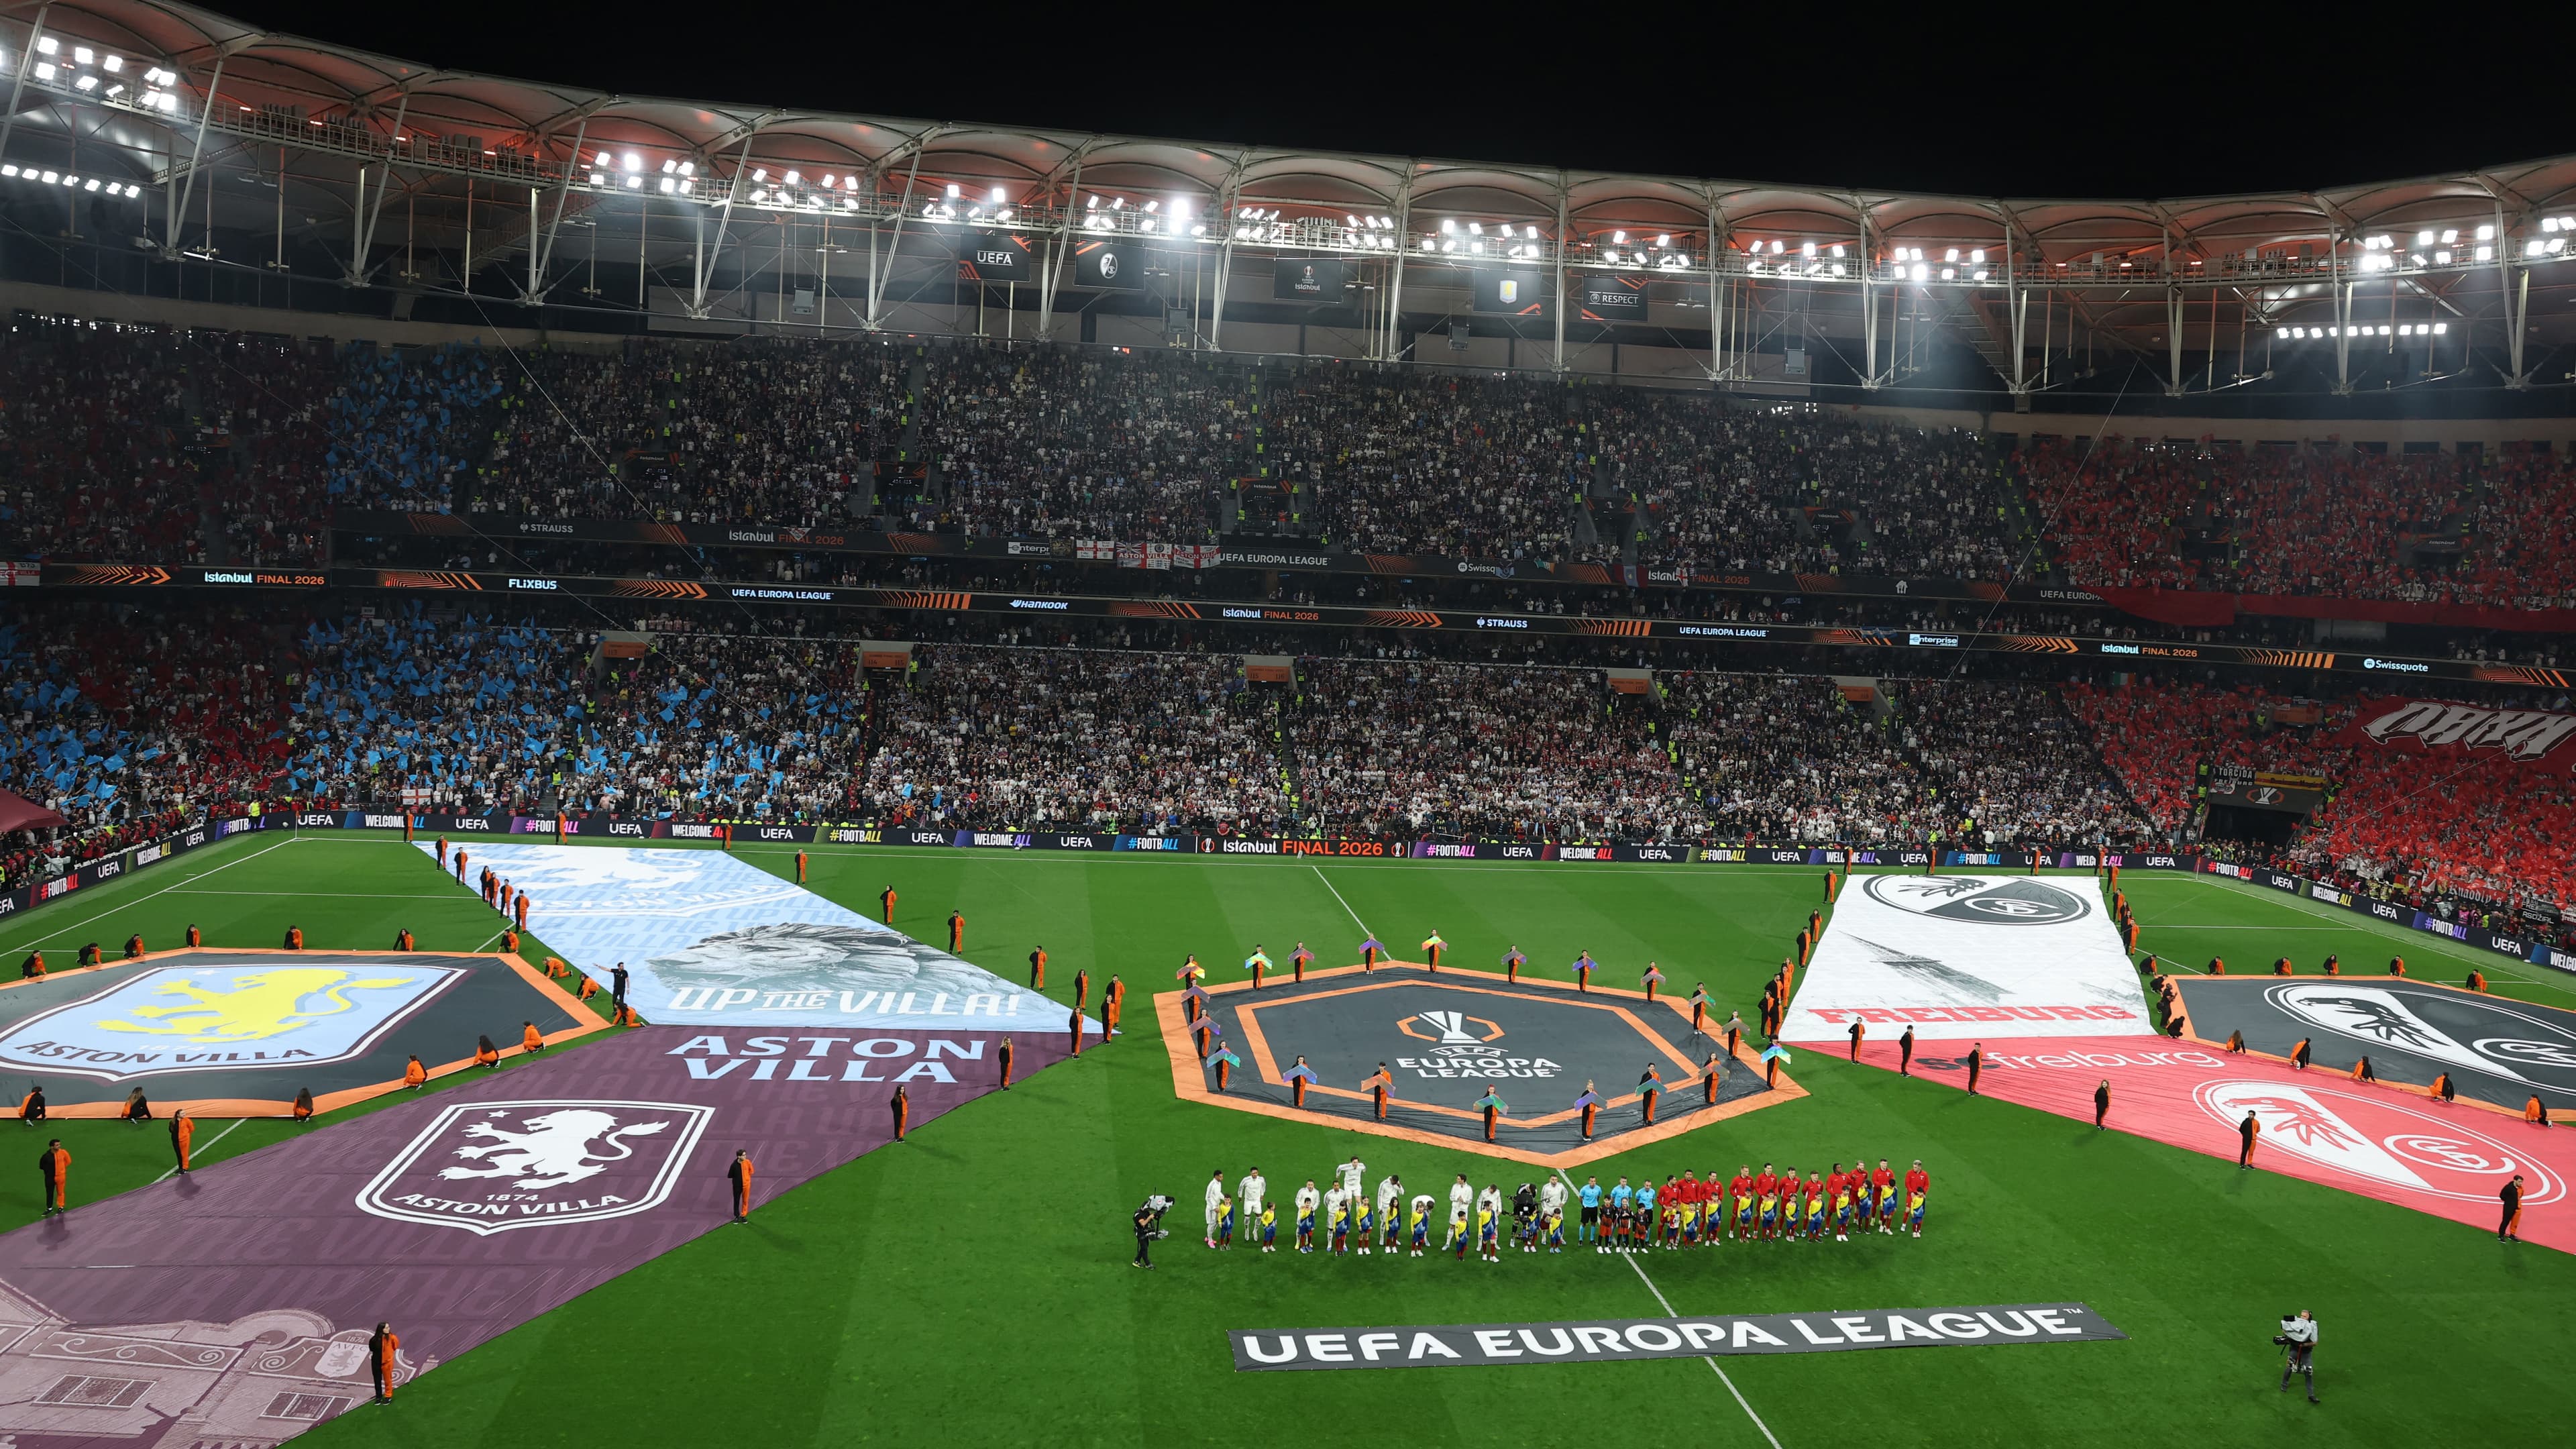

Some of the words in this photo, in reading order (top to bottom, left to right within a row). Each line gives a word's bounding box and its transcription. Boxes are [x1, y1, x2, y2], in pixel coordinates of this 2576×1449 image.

[977, 252, 1014, 265] UEFA
[1295, 283, 1320, 291] Istanbul
[1602, 294, 1639, 304] RESPECT
[531, 523, 574, 533] STRAUSS
[729, 529, 774, 543] Istanbul
[815, 535, 845, 545] 2026
[1247, 555, 1287, 564] EUROPA
[1468, 564, 1495, 575] Swissq
[204, 571, 253, 584] Istanbul
[256, 575, 292, 584] FINAL
[294, 576, 325, 585] 2026
[1725, 576, 1750, 585] 2026
[732, 588, 757, 597] UEFA
[758, 590, 794, 599] EUROPA
[2040, 590, 2065, 599] UEFA
[1223, 607, 1261, 619] Istanbul
[1264, 611, 1292, 621] FINAL
[1294, 612, 1319, 621] 2026
[1487, 619, 1528, 629] STRAUSS
[1679, 626, 1701, 635] UEFA
[1702, 627, 1734, 637] EUROPA
[2101, 643, 2139, 655] Istanbul
[2142, 647, 2169, 657] FINAL
[2171, 648, 2198, 658] 2026
[2375, 659, 2428, 672] Swissquote
[2218, 767, 2253, 779] TORCIDA
[223, 816, 266, 835] #FOOTBL
[298, 814, 334, 826] UEFA
[411, 816, 425, 828] LL
[455, 818, 489, 830] UEFA
[525, 820, 579, 833] #FOOTALL
[609, 823, 643, 835] UEFA
[672, 824, 712, 838] WELCOME
[761, 828, 794, 840] UEFA
[186, 832, 205, 847] UEFA
[829, 829, 882, 843] #FOOTBALL
[912, 832, 945, 844] UEFA
[973, 833, 1013, 846] WELCOME
[1014, 834, 1031, 847] ALL
[1061, 836, 1093, 847] UEFA
[1128, 837, 1179, 851] #FOOTBALL
[1223, 839, 1277, 854] Istanbul
[1282, 841, 1334, 855] FINAL
[1339, 842, 1383, 857] 2026
[1427, 844, 1476, 857] #FOOTBALL
[137, 848, 162, 866] WELCOME
[161, 842, 172, 857] ALL
[1503, 847, 1534, 858] UEFA
[1560, 847, 1596, 859] WELCOME
[1596, 847, 1613, 860] ALL
[1639, 849, 1668, 860] UEFA
[1700, 849, 1746, 861] #FOOTBALL
[1772, 851, 1801, 861] UEFA
[1826, 851, 1860, 863] WELCME
[1860, 852, 1876, 863] ALL
[1900, 853, 1928, 863] UEFA
[1957, 853, 2002, 865] #FOOTBALL
[2025, 855, 2053, 865] UFA
[2076, 855, 2108, 866] WELCE
[2108, 855, 2123, 867] ALL
[2146, 856, 2176, 867] UEFA
[97, 861, 120, 879] UEFA
[2207, 861, 2253, 881] #FOOTBALL
[40, 873, 79, 900] #FOOTBALL
[2271, 875, 2294, 890] UEFA
[2312, 885, 2341, 904] WELCOME
[2339, 893, 2353, 908] ALL
[2372, 902, 2398, 920] UEFA
[2424, 917, 2468, 941] #FOOTBALL
[2491, 935, 2522, 955] UEFA
[668, 987, 759, 1012] UP
[762, 989, 831, 1010] THE
[839, 991, 1022, 1017] VILLA!
[1807, 1005, 2139, 1024] FREIBURG
[15, 1041, 163, 1063] ASTON
[175, 1049, 317, 1063] VILLA
[663, 1035, 987, 1061] ASTON
[1397, 1058, 1562, 1069] EUROPA
[683, 1058, 959, 1084] VILLA
[392, 1193, 511, 1216] ASTON
[519, 1194, 629, 1216] VILLA
[1242, 1331, 1462, 1364] UEFA
[1472, 1318, 1787, 1359] EUROPA
